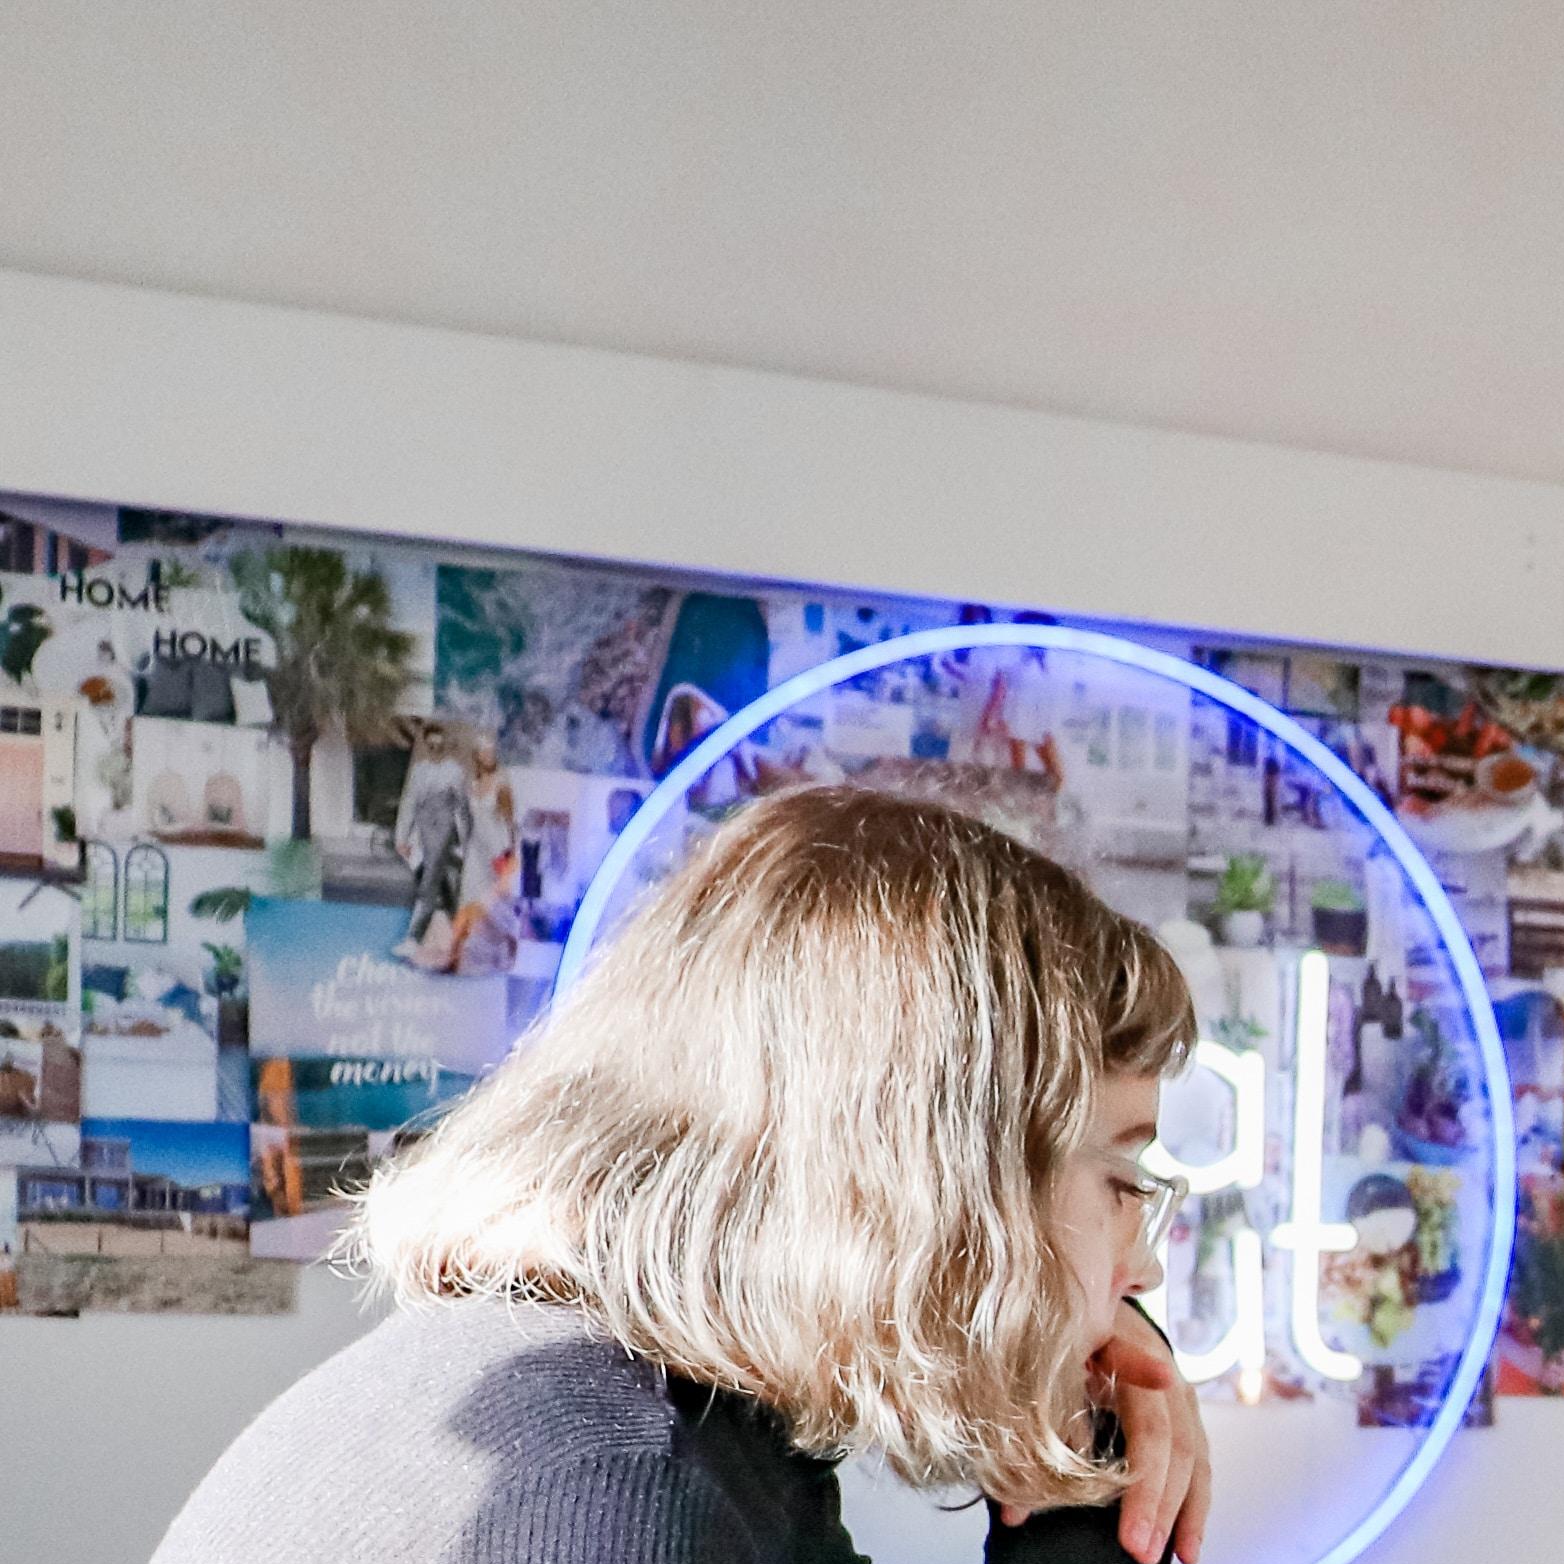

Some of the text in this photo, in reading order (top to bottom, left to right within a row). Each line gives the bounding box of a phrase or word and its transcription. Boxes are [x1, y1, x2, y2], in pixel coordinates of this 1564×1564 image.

[60, 573, 170, 613] HOME
[153, 627, 262, 667] HOME
[330, 1060, 438, 1099] money
